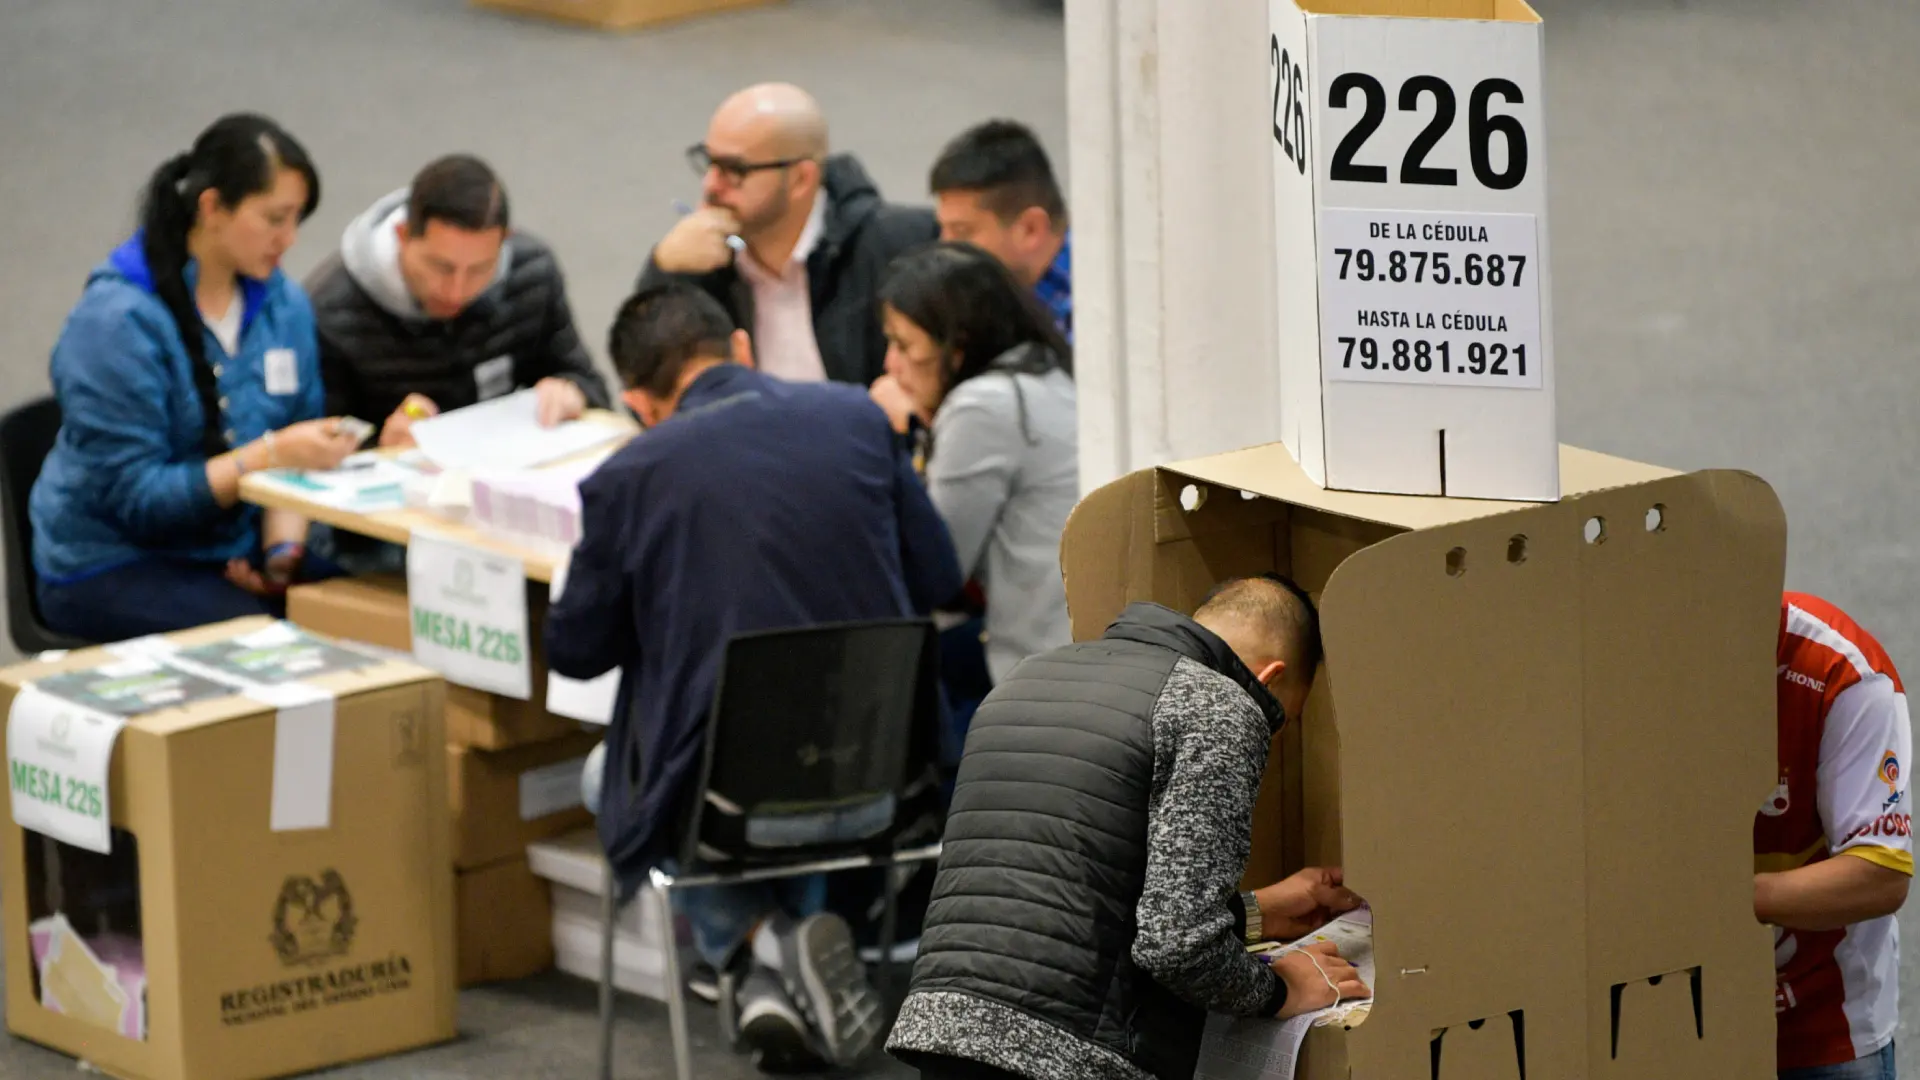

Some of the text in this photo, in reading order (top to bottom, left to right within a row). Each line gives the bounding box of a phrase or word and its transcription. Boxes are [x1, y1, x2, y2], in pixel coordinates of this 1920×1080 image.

[1271, 33, 1305, 175] 226
[1328, 72, 1528, 190] 226
[1369, 221, 1489, 243] DE LA CÉDULA
[1334, 247, 1527, 287] 79.875.687
[1357, 309, 1508, 333] HASTA LA CÉDULA
[1337, 336, 1527, 377] 79.881.921
[413, 605, 522, 664] MESA 226
[11, 757, 103, 819] MESA 226
